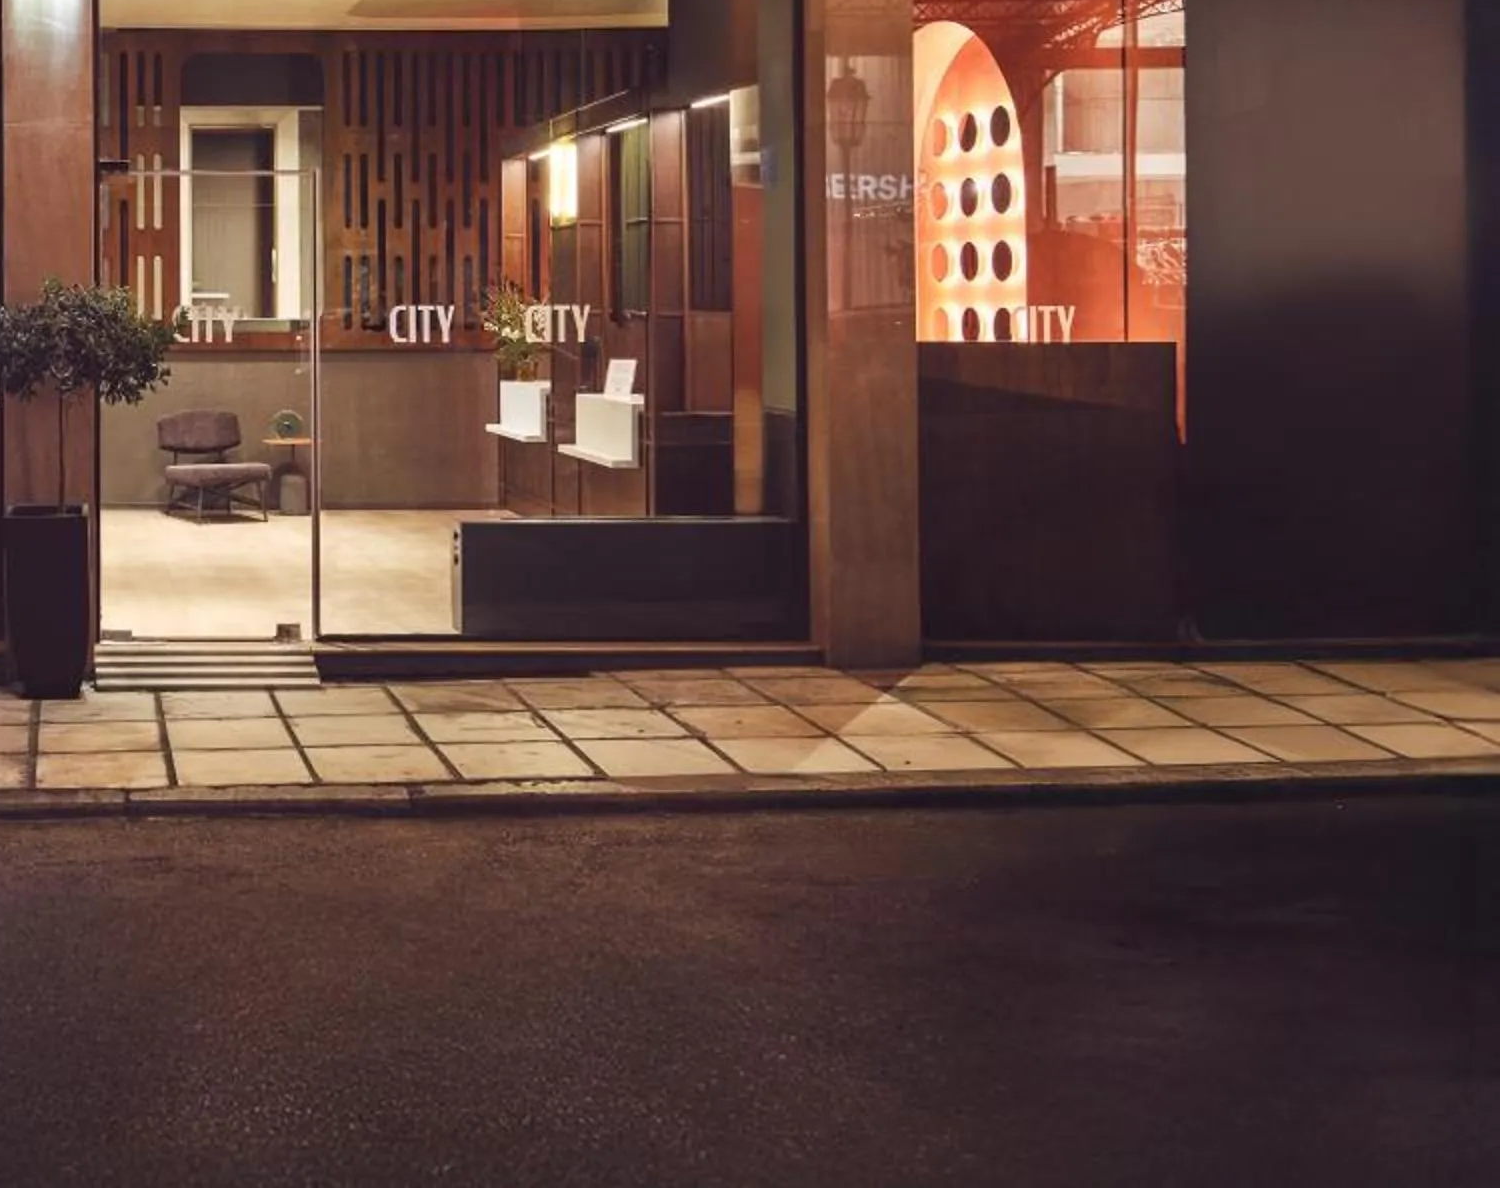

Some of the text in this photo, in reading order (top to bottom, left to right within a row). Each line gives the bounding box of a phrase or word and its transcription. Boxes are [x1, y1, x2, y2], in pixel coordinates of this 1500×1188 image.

[172, 304, 240, 343] CITY
[388, 304, 456, 343] CITY
[524, 304, 591, 343] CITY
